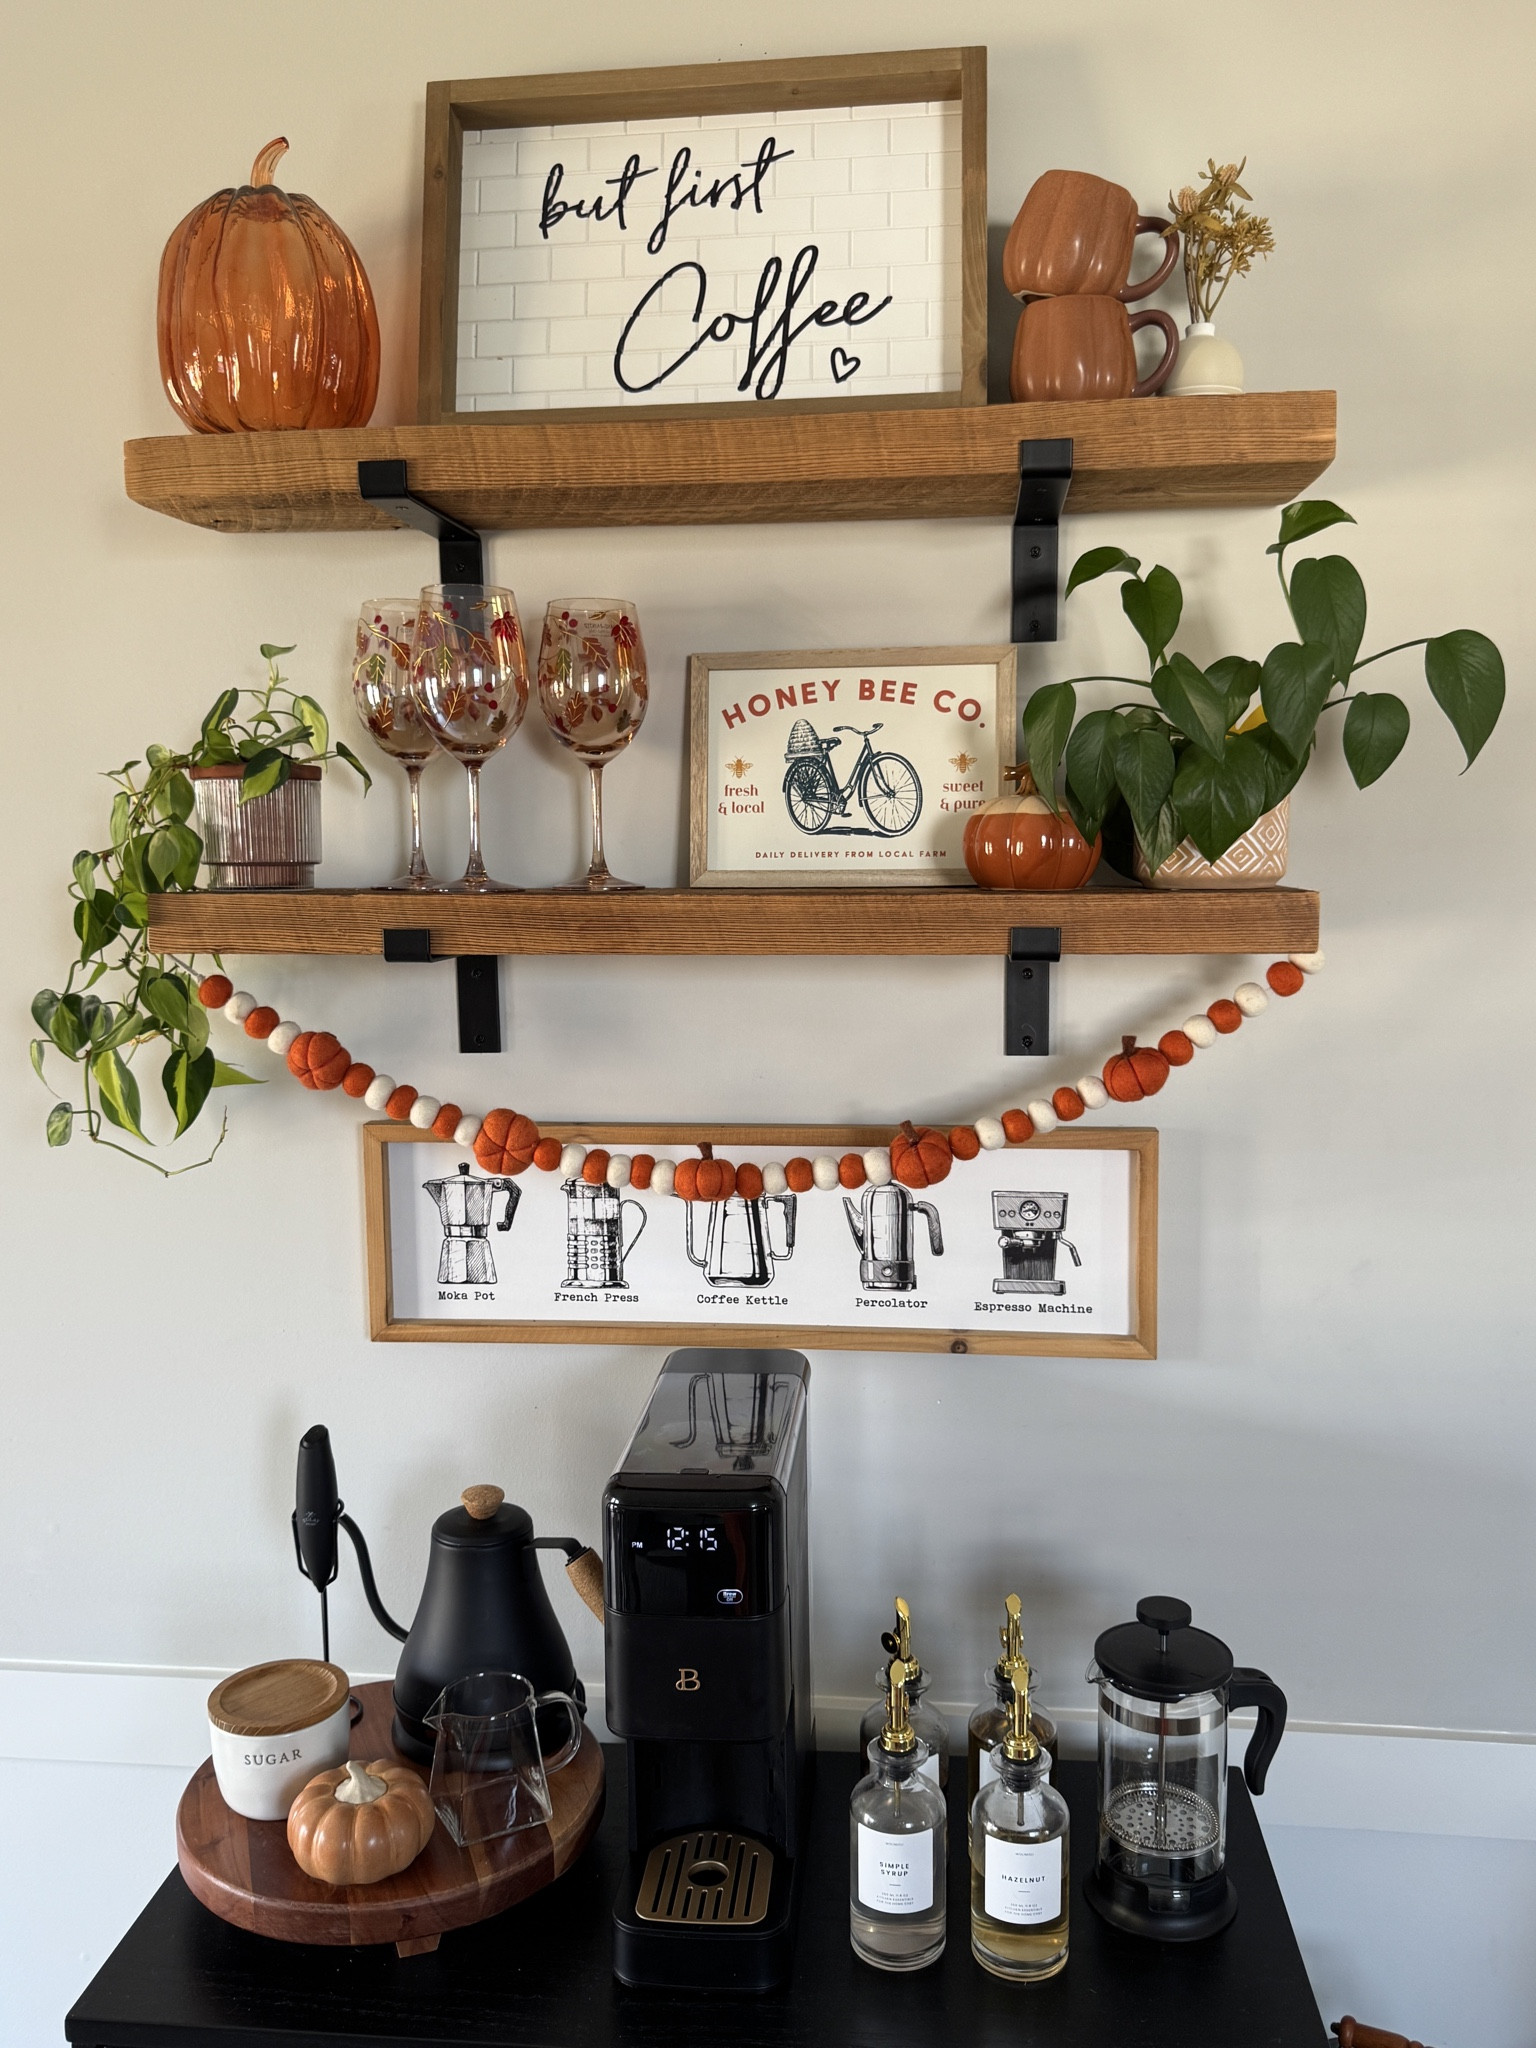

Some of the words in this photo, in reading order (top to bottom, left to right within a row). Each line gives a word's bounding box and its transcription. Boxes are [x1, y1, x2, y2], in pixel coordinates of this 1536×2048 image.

[539, 154, 658, 239] but
[647, 137, 794, 254] first
[614, 245, 893, 400] Coffee
[721, 679, 841, 730] HONEY
[858, 679, 918, 706] BEE
[933, 689, 986, 729] CO.
[724, 783, 759, 797] fresh
[942, 780, 984, 793] sweet
[718, 802, 728, 816] &
[731, 801, 765, 814] local
[940, 798, 949, 812] &
[755, 851, 785, 859] DAILY
[790, 851, 840, 859] DELIVERY
[845, 851, 874, 859] FROM
[879, 850, 914, 858] LOCAL
[919, 850, 947, 858] FARM
[438, 1290, 468, 1301] Moka
[475, 1290, 496, 1301] Pot
[554, 1292, 598, 1303] French
[605, 1292, 639, 1303] Press
[697, 1294, 740, 1305] Coffee
[746, 1295, 788, 1306] Kettle
[855, 1297, 928, 1309] Percolator
[974, 1301, 1032, 1314] Espresso
[1038, 1303, 1093, 1314] Machine
[667, 1527, 717, 1551] 12:15
[244, 1749, 302, 1765] SUGAR
[880, 1862, 909, 1870] SIMPLE
[881, 1869, 908, 1877] SYRUP
[1002, 1874, 1045, 1883] HAZELNUT
